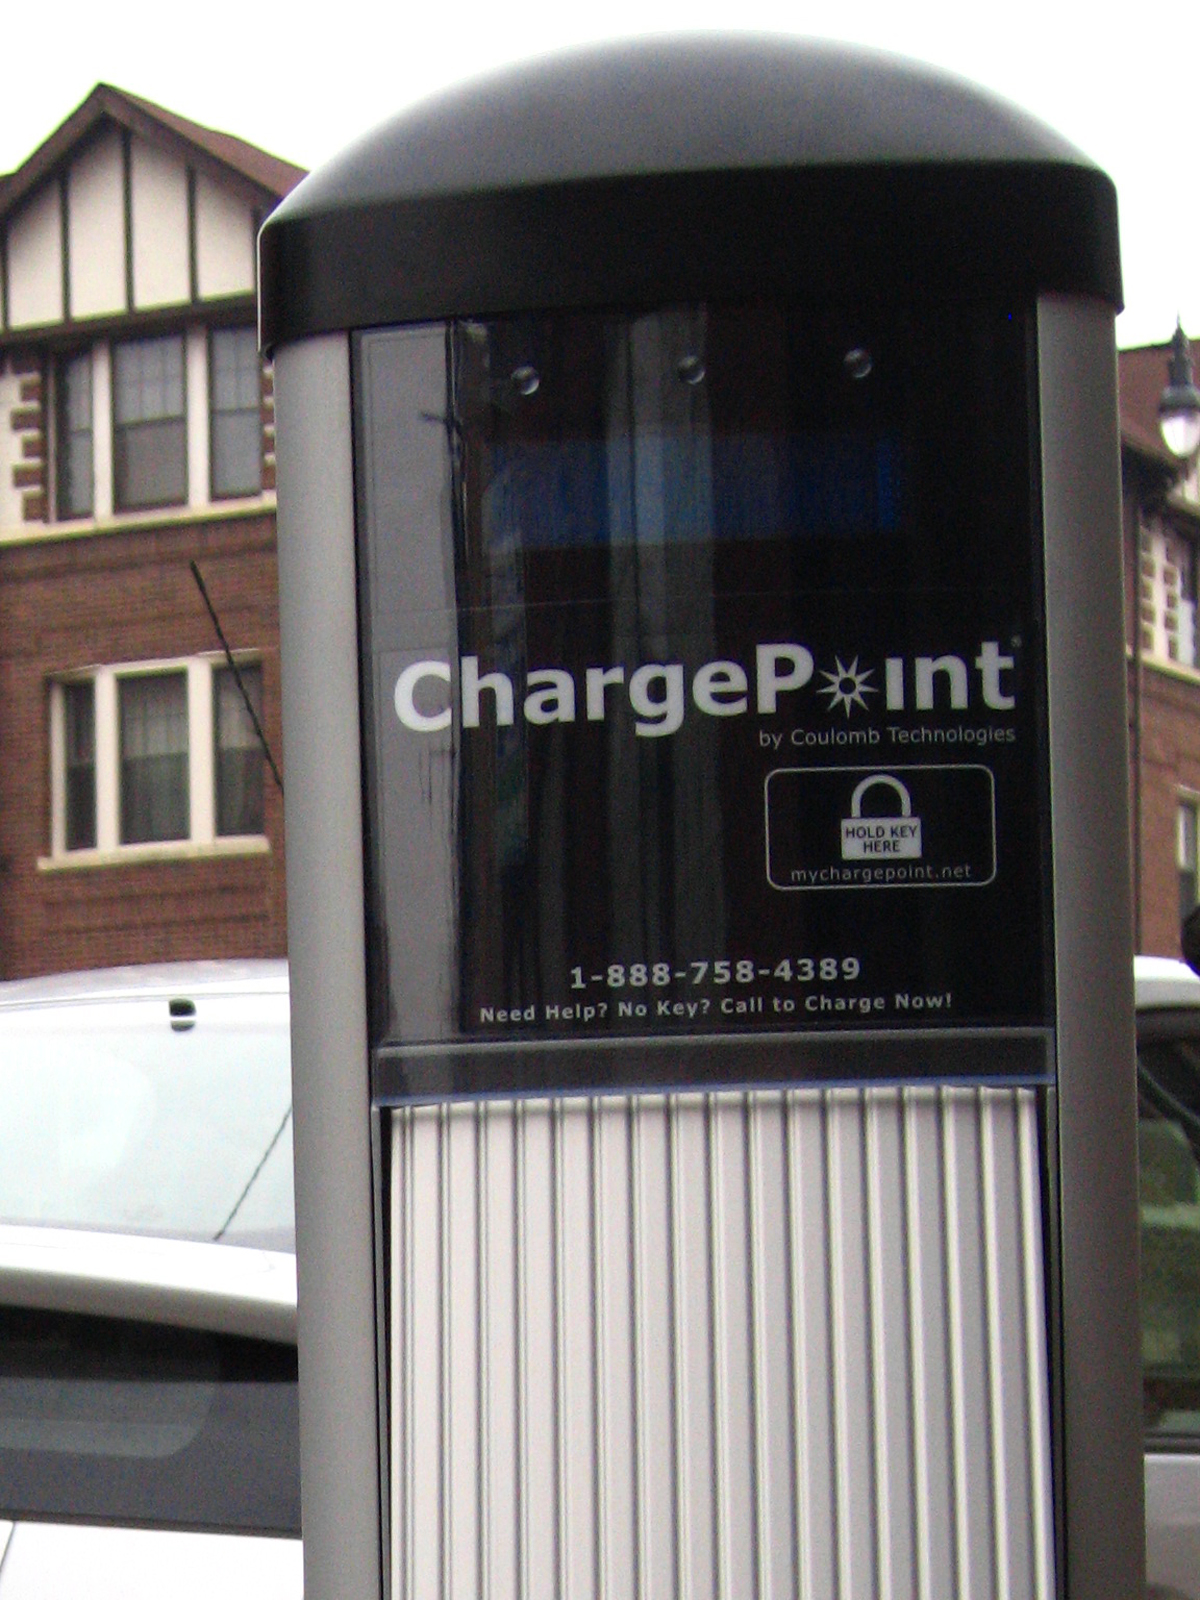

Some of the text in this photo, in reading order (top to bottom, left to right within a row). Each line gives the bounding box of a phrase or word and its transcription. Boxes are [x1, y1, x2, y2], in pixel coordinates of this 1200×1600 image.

[759, 725, 1016, 749] by Coulomb Technologies
[845, 825, 918, 838] HOLD KEY
[863, 840, 900, 853] HERE
[791, 865, 972, 884] mychargepoint.net
[570, 957, 861, 990] 1-888-758-4389
[479, 992, 953, 1023] Need Help? No Key? Call to Charge Now!
